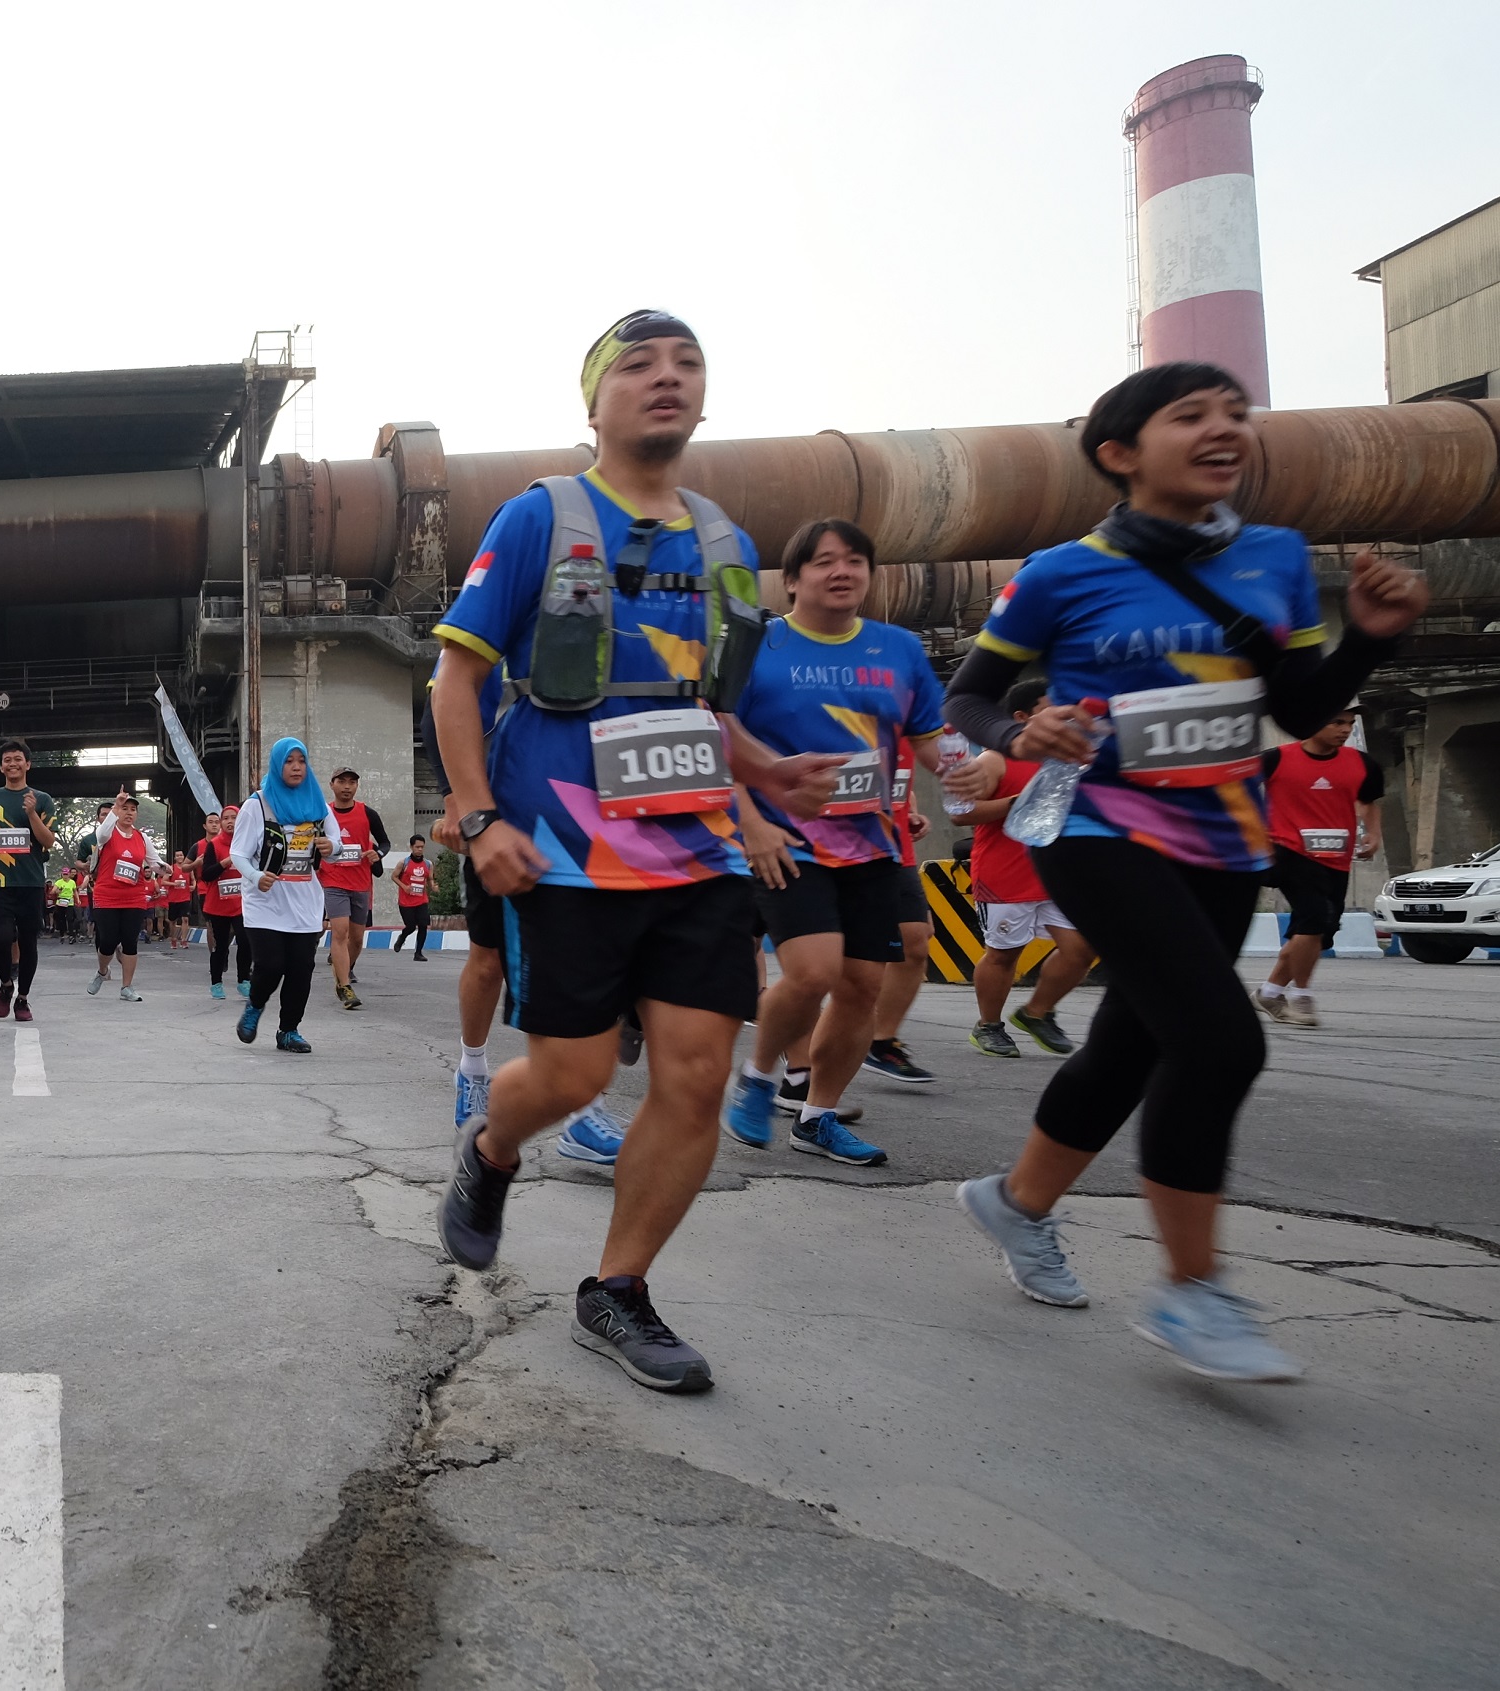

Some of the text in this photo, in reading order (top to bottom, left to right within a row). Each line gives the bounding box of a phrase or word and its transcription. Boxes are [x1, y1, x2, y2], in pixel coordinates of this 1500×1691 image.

[617, 742, 717, 783] 1099
[828, 772, 874, 797] 127
[1, 836, 26, 846] 1898
